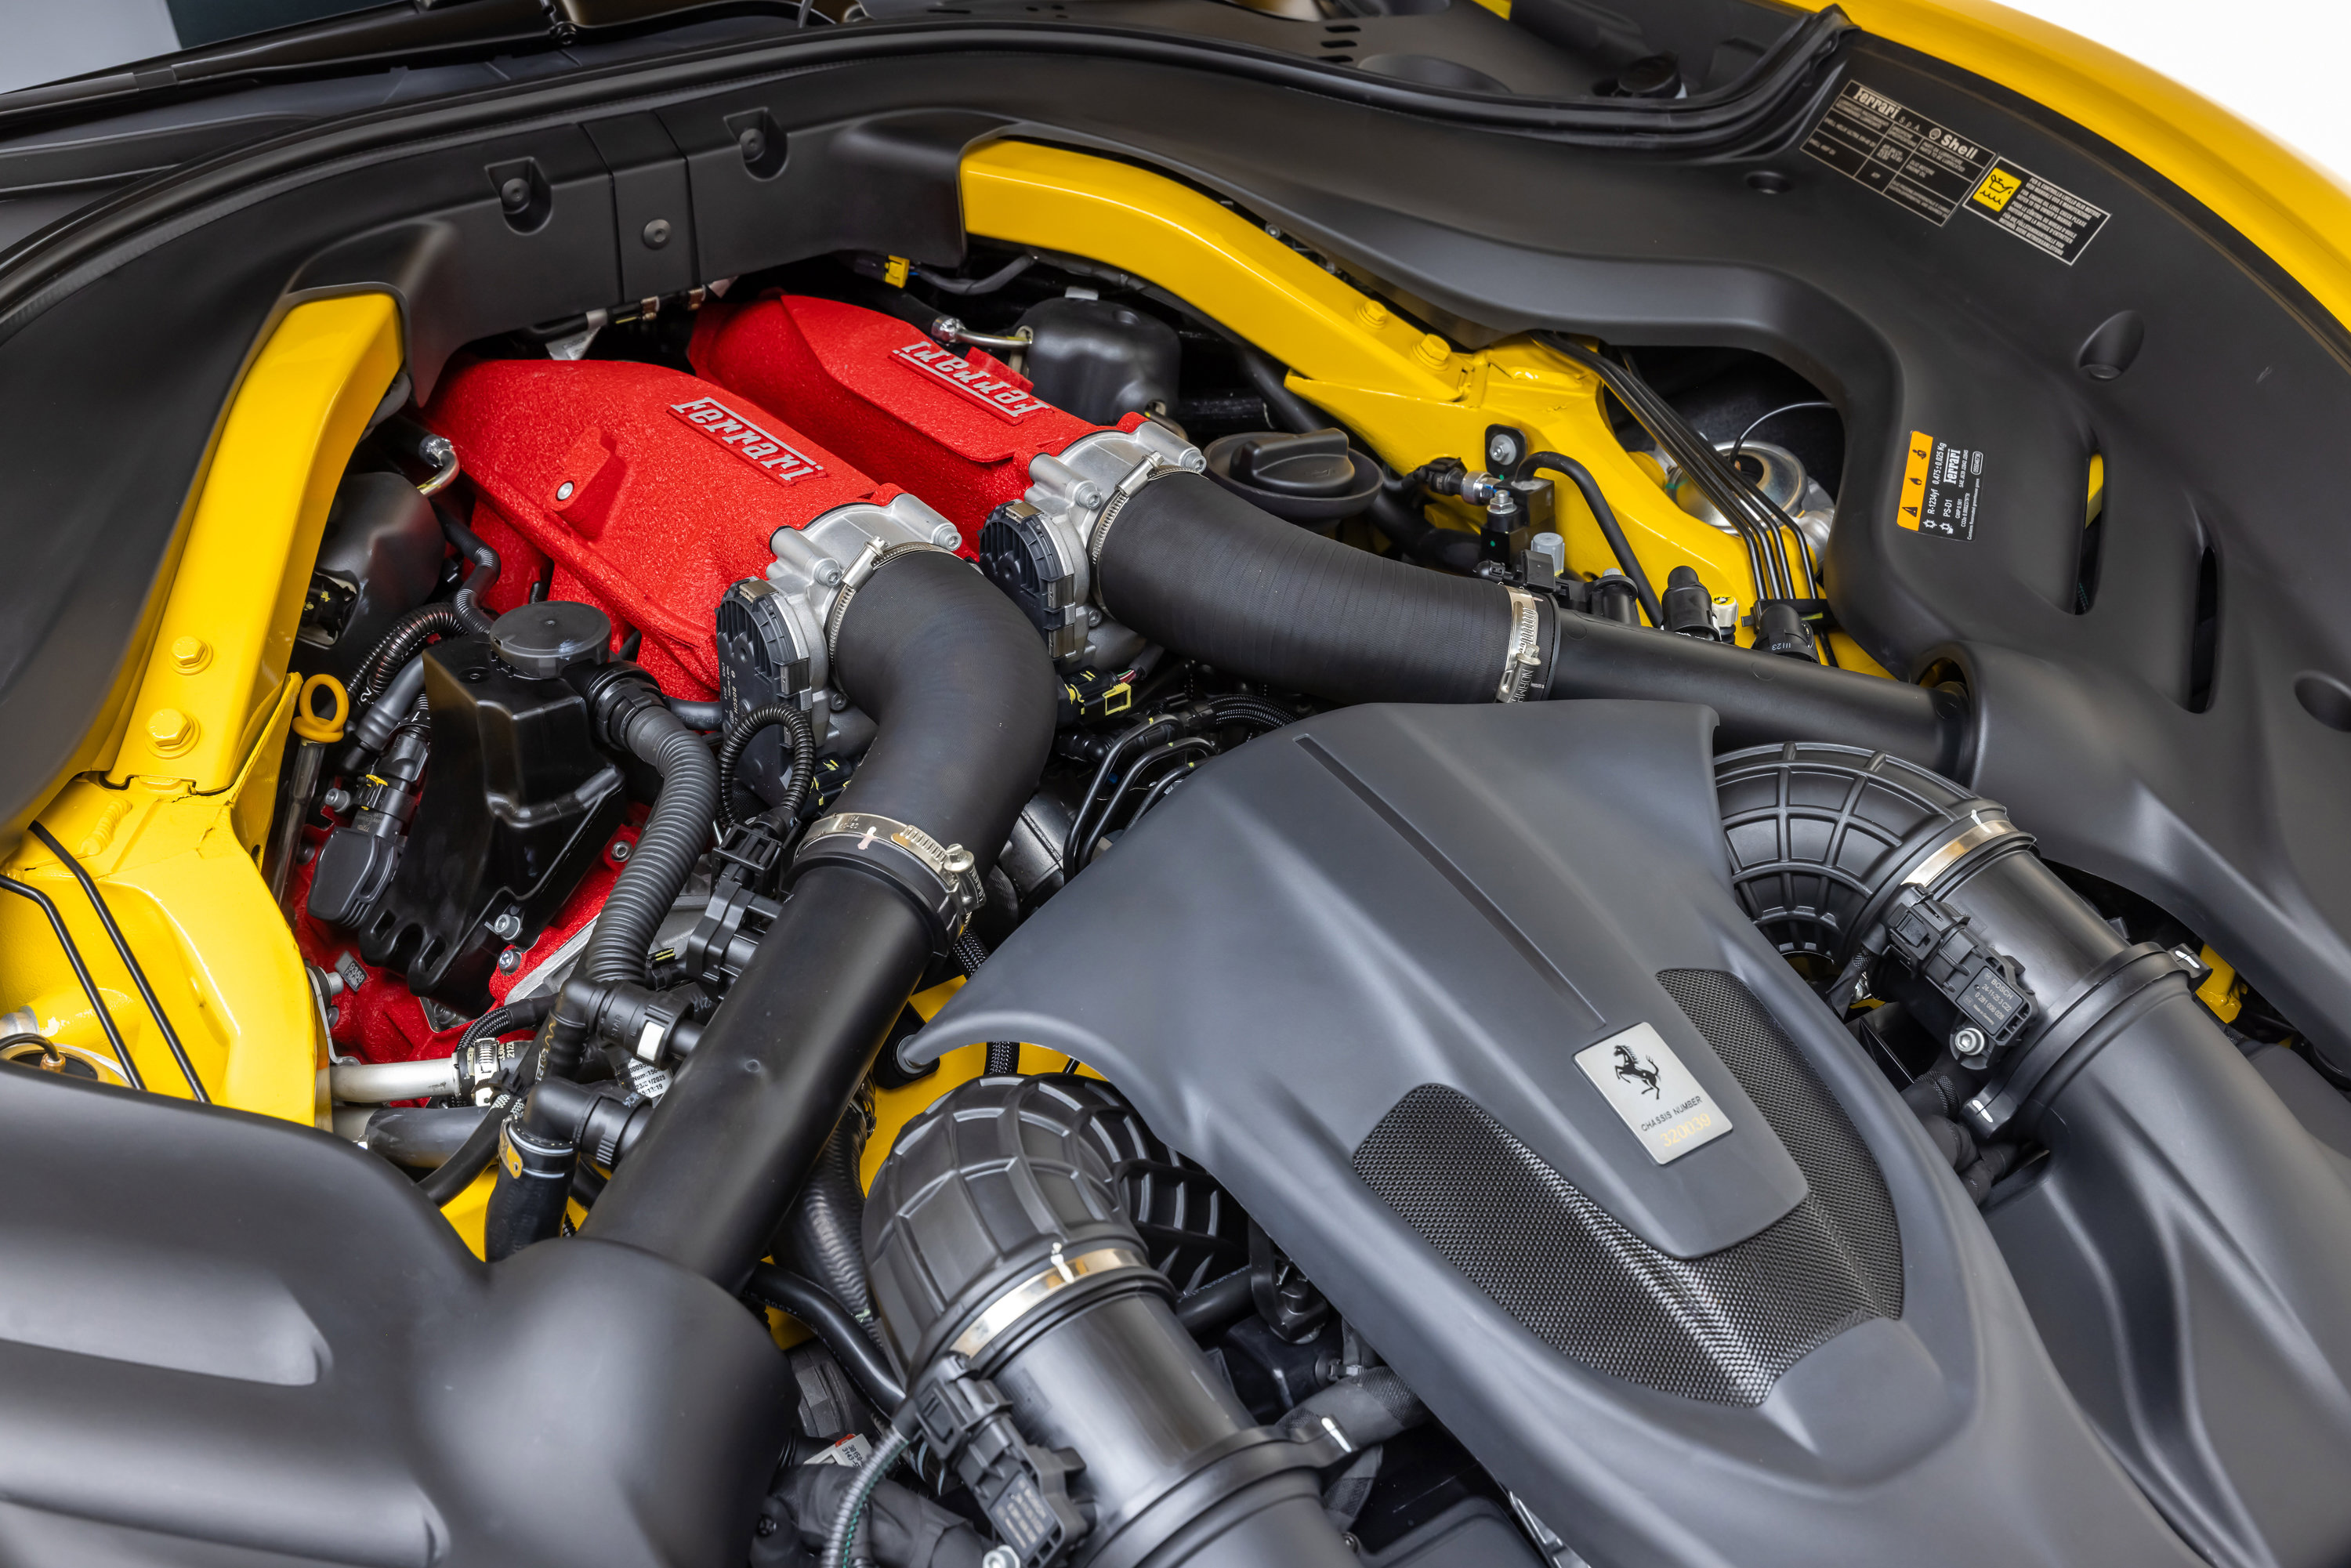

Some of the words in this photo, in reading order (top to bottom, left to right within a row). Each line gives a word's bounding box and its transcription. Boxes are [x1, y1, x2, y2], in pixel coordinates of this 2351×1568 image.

[1853, 87, 1901, 118] Ferrari
[1940, 133, 1979, 159] Shell
[892, 341, 1050, 418] Ferrari
[670, 397, 824, 482] Ferrari
[1928, 488, 1940, 514] R-1234yf
[1937, 442, 1947, 451] Kg
[1943, 448, 1961, 484] Ferrari
[1943, 499, 1952, 517] PS-D1
[1991, 979, 2014, 1000] BOSCH
[1978, 995, 1987, 1005] 281
[1994, 1010, 2005, 1020] 028
[639, 1084, 663, 1095] 5:13:19
[1641, 1110, 1672, 1132] CHASSIS
[1673, 1095, 1703, 1115] NUMBER
[1660, 1113, 1712, 1147] 320039
